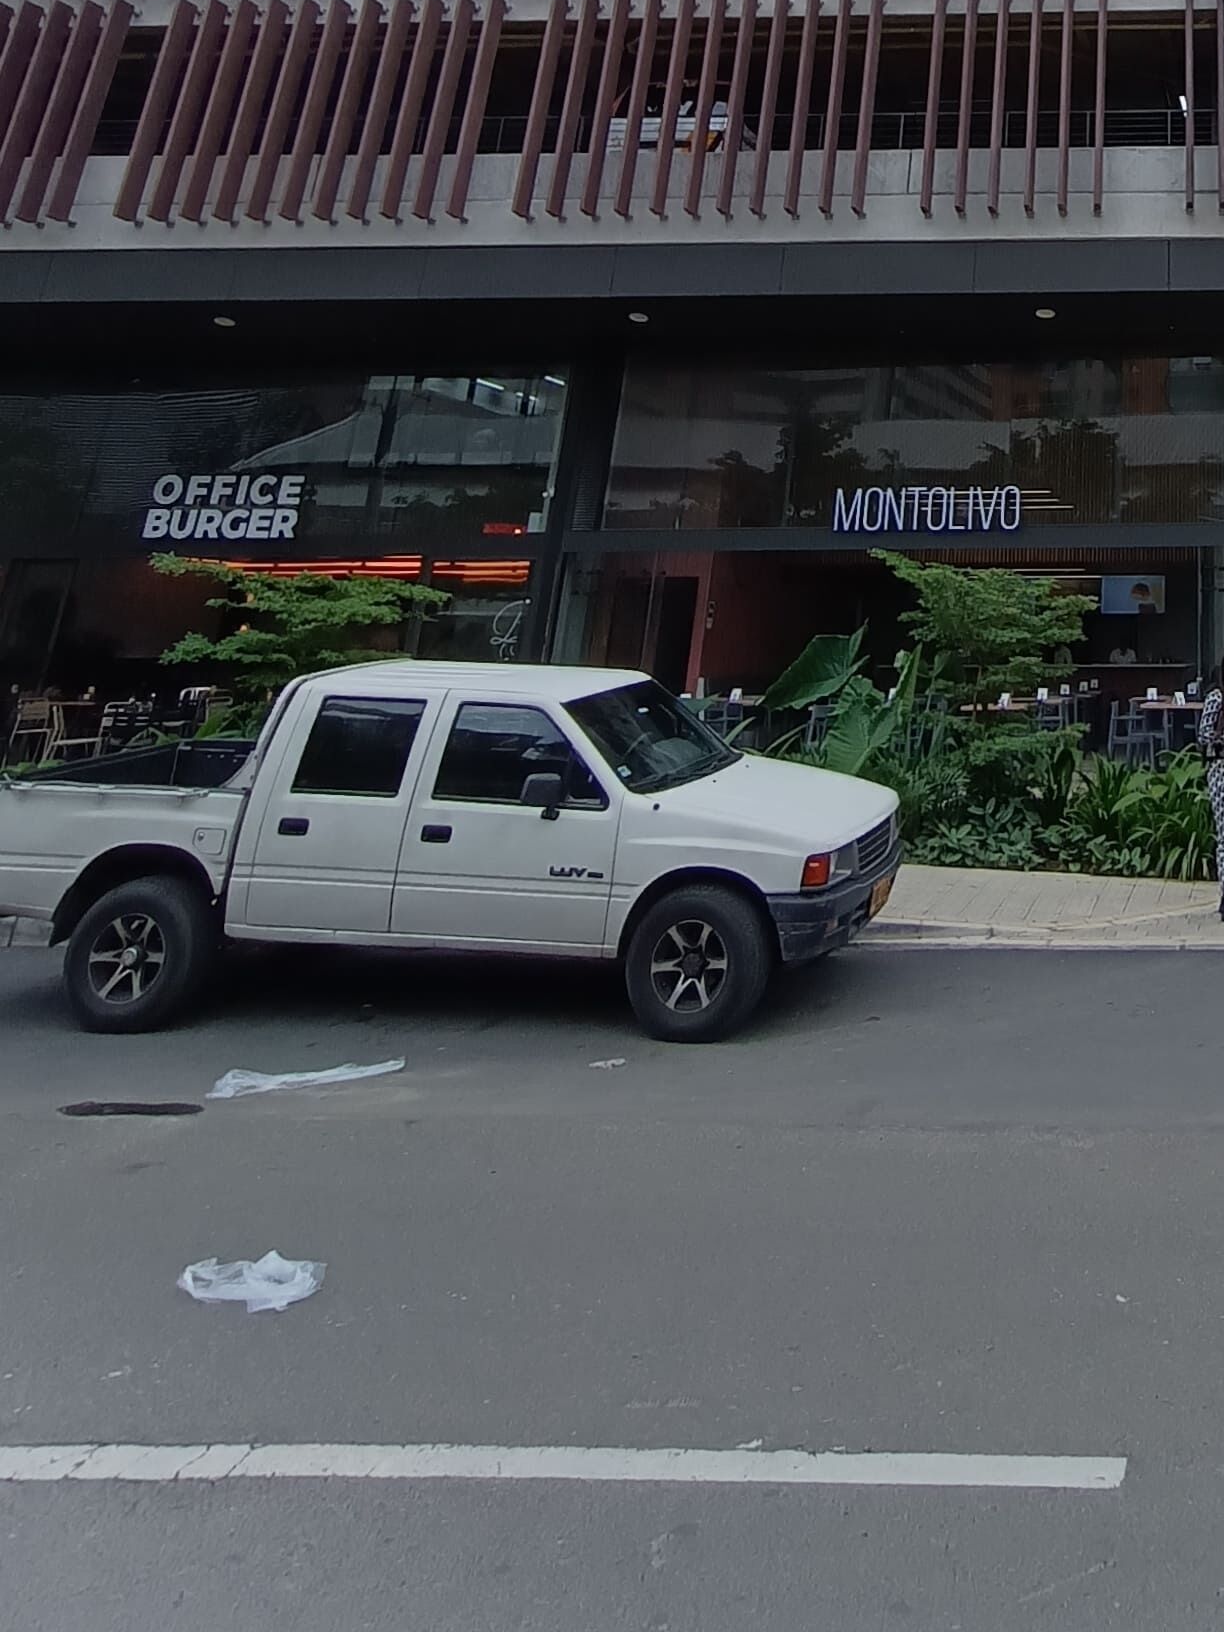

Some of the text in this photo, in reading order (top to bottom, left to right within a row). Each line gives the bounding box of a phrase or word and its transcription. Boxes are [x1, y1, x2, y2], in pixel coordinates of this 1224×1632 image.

[153, 474, 305, 505] OFFICE
[142, 508, 299, 539] BURGER
[833, 485, 1021, 532] MONTOLIVO
